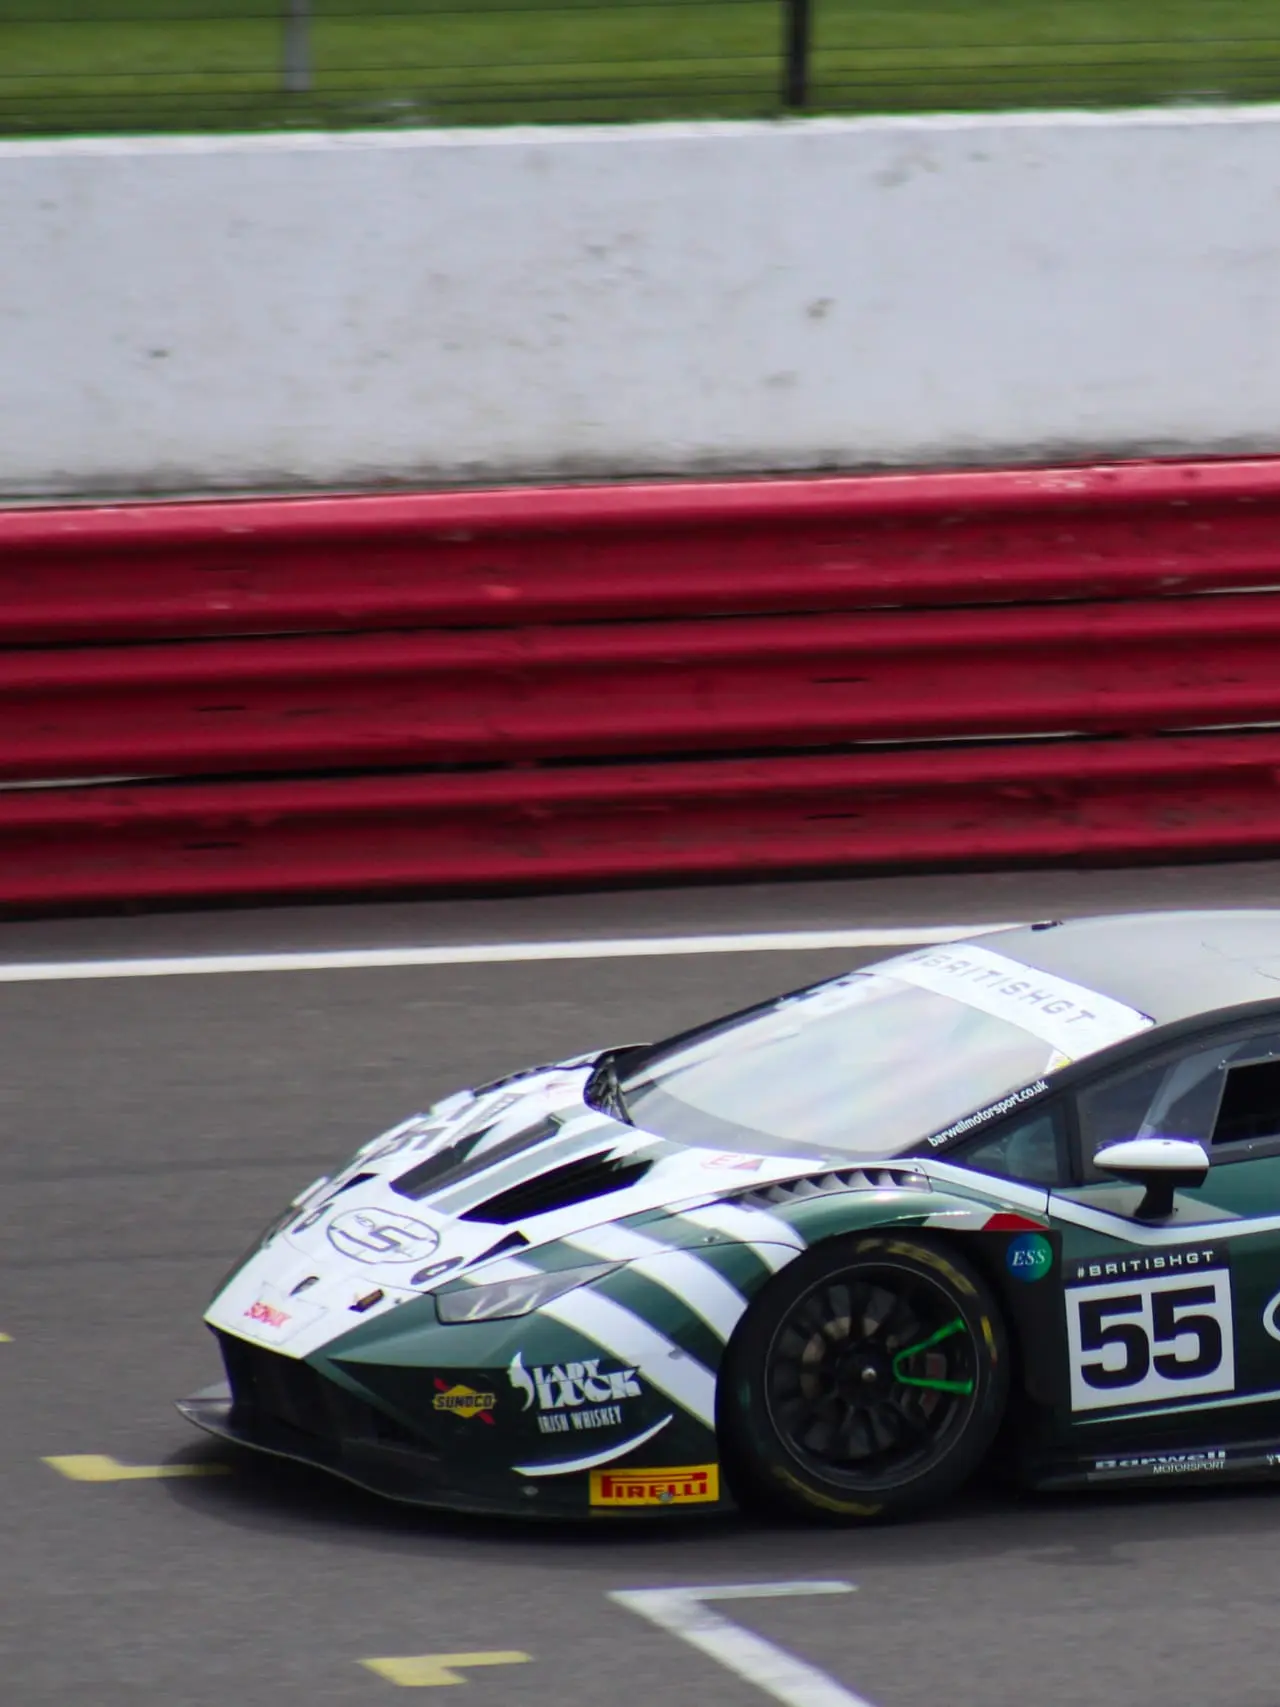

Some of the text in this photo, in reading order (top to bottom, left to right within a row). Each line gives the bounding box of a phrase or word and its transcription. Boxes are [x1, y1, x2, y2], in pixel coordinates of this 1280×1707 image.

[927, 1079, 1049, 1148] barwellmotorsport.co.uk
[1012, 1248, 1046, 1267] ESS
[1077, 1250, 1214, 1278] #BRITISHGT
[1078, 1284, 1223, 1390] 55
[437, 1394, 494, 1408] SUNOCO
[537, 1405, 622, 1433] IRISH WHISKEY
[1152, 1459, 1226, 1474] MOTORSPORT
[601, 1471, 708, 1499] PIRELLI
